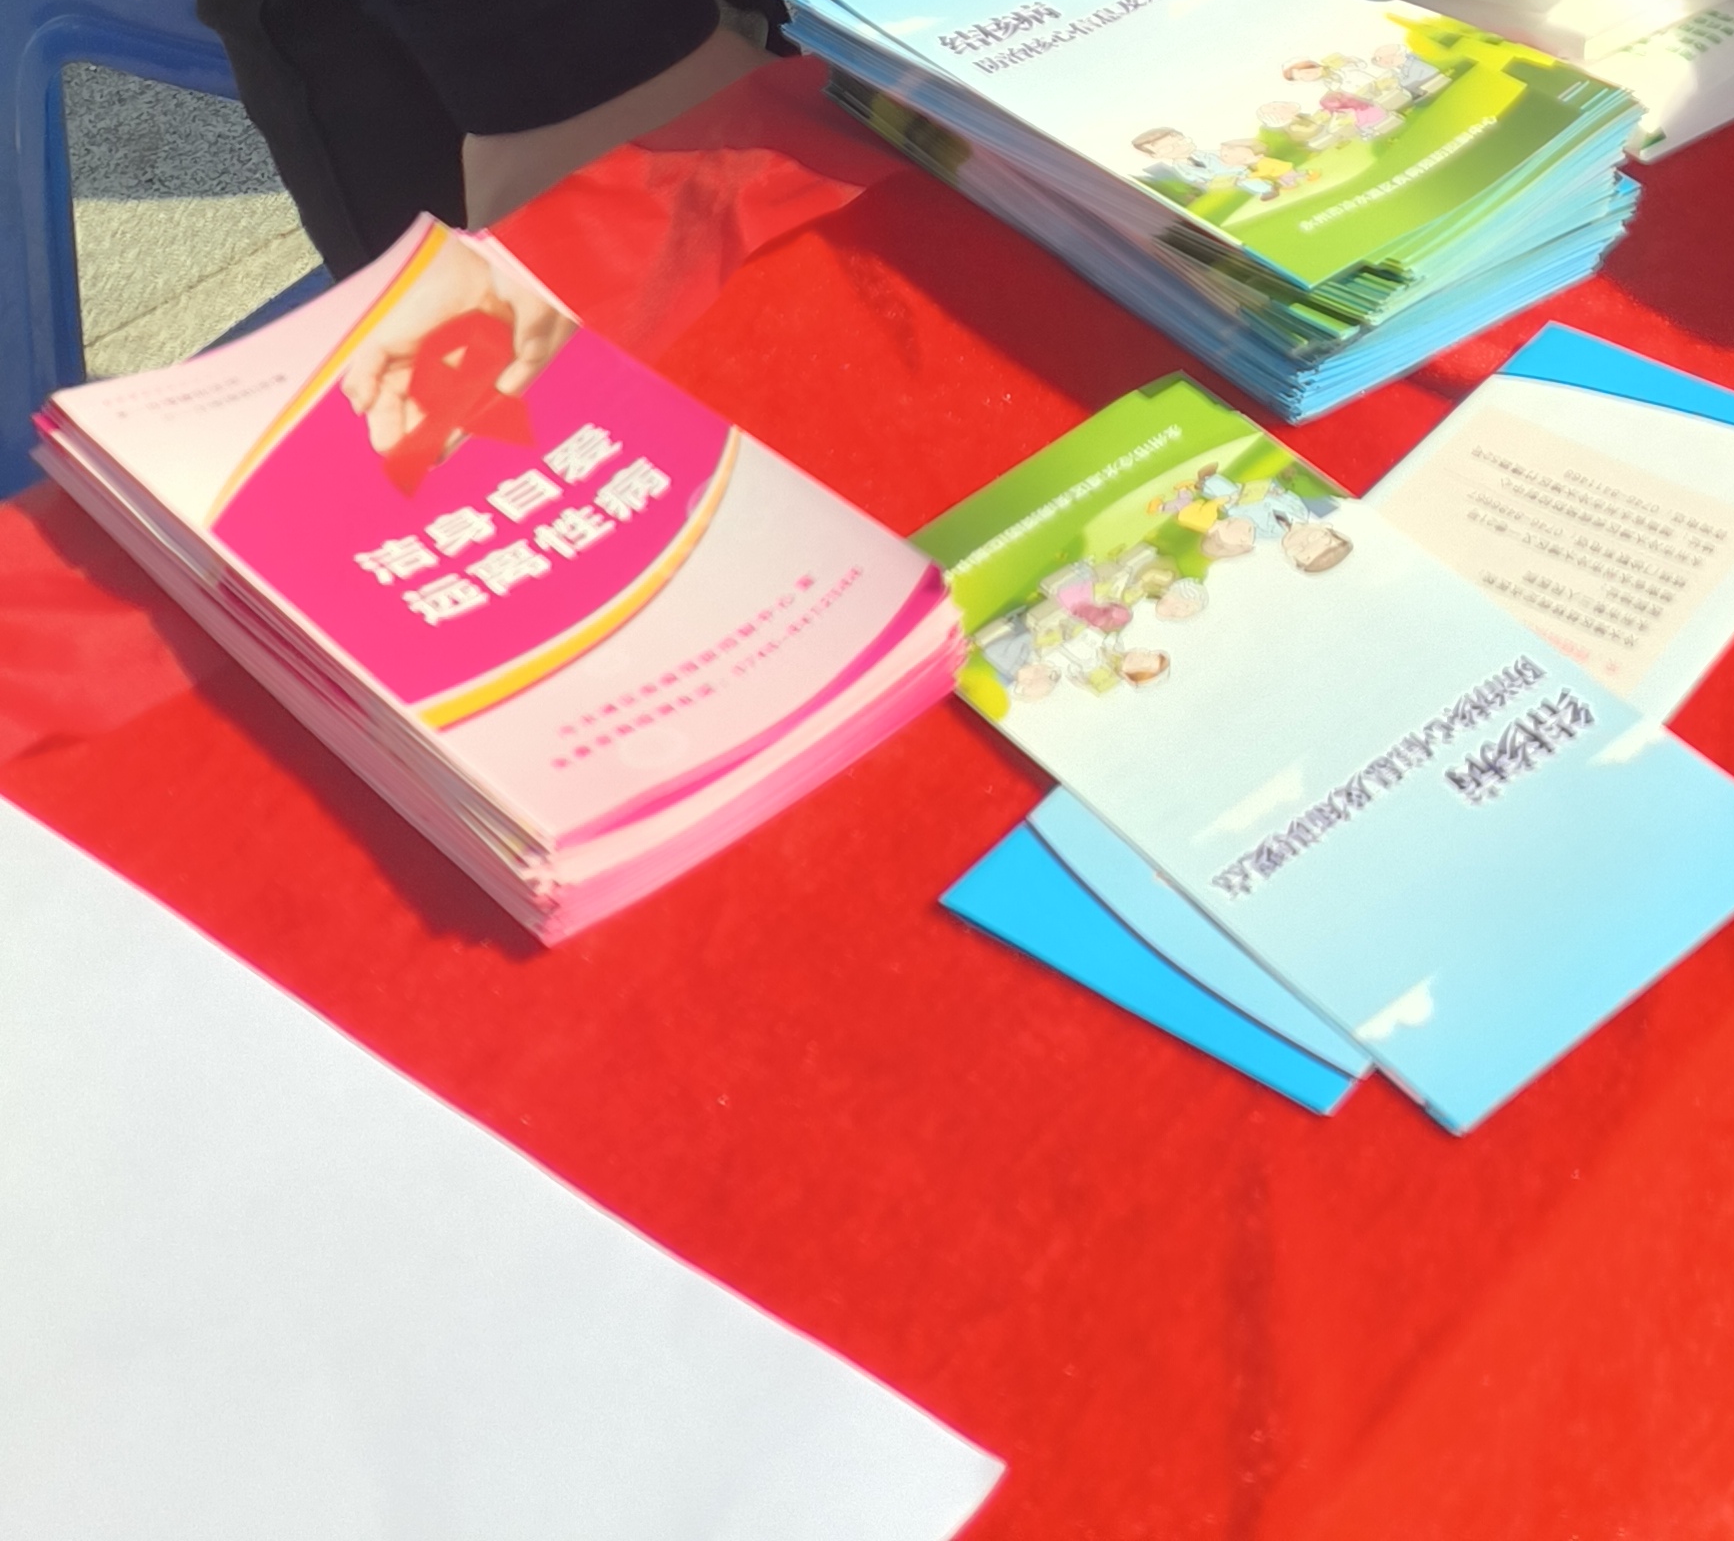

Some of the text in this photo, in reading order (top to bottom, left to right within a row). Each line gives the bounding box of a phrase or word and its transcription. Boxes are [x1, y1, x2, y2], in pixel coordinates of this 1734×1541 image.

[353, 422, 623, 585] 洁身自爱
[402, 456, 672, 627] 远离性病
[1209, 655, 1548, 901] 防治核心信息及知识要点
[1445, 688, 1598, 806] 结核病
